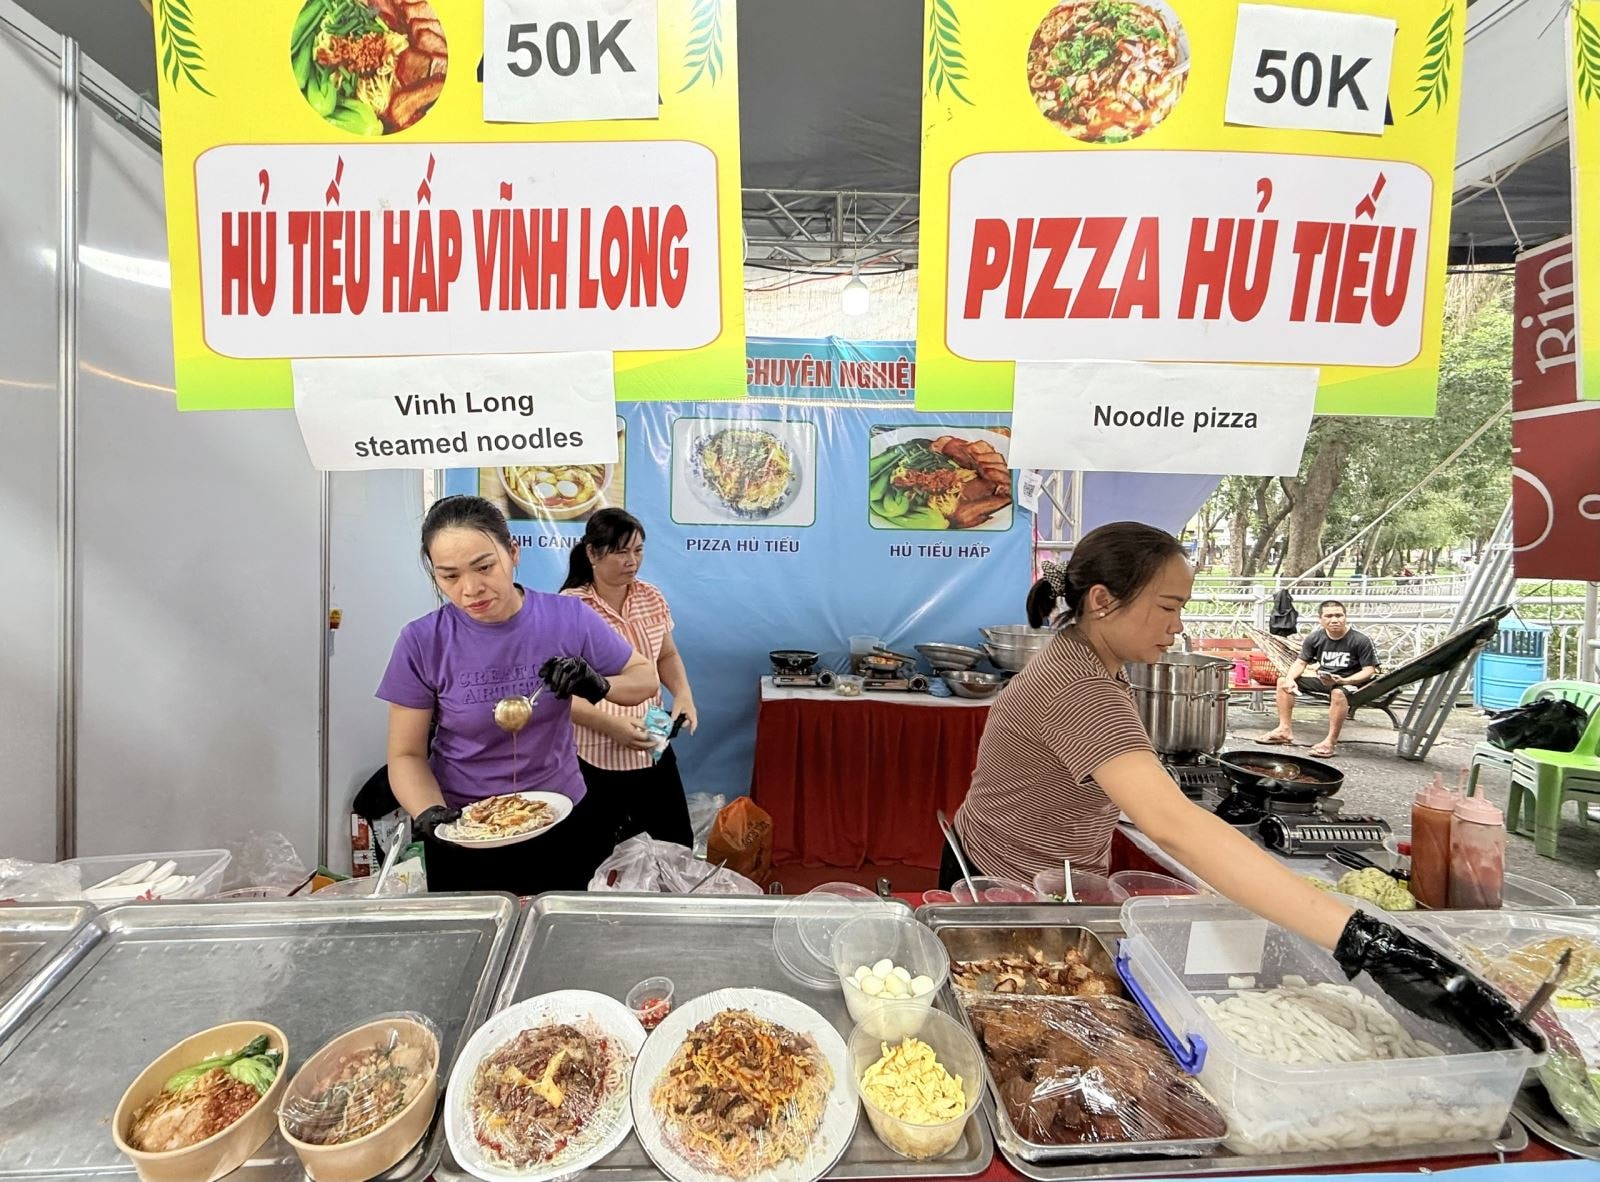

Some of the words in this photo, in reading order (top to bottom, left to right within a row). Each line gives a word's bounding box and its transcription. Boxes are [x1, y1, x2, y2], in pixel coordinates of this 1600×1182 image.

[507, 19, 637, 77] 50K
[1253, 49, 1373, 111] 50K
[222, 169, 277, 317] HỦ
[288, 155, 371, 316] TIẾU
[382, 152, 463, 313] HẤP
[472, 181, 568, 311] VĨNH
[579, 204, 689, 310] LONG
[963, 217, 1160, 319] PIZZA
[1178, 178, 1279, 322] HỦ
[1289, 172, 1417, 327] TIẾU
[839, 357, 916, 395] NGHIỆ
[394, 393, 456, 416] Vinh
[466, 392, 534, 416] Long
[1093, 405, 1185, 427] Noodle
[1193, 407, 1258, 433] pizza
[354, 431, 468, 457] steamed
[477, 427, 584, 452] noodles
[686, 539, 731, 551] PIZZA
[737, 537, 759, 551] HỦ
[764, 536, 800, 552] TIẾU
[890, 541, 912, 556] HỦ
[918, 541, 952, 557] TIẾU
[958, 542, 991, 557] HẤP
[1321, 651, 1351, 667] NIKE
